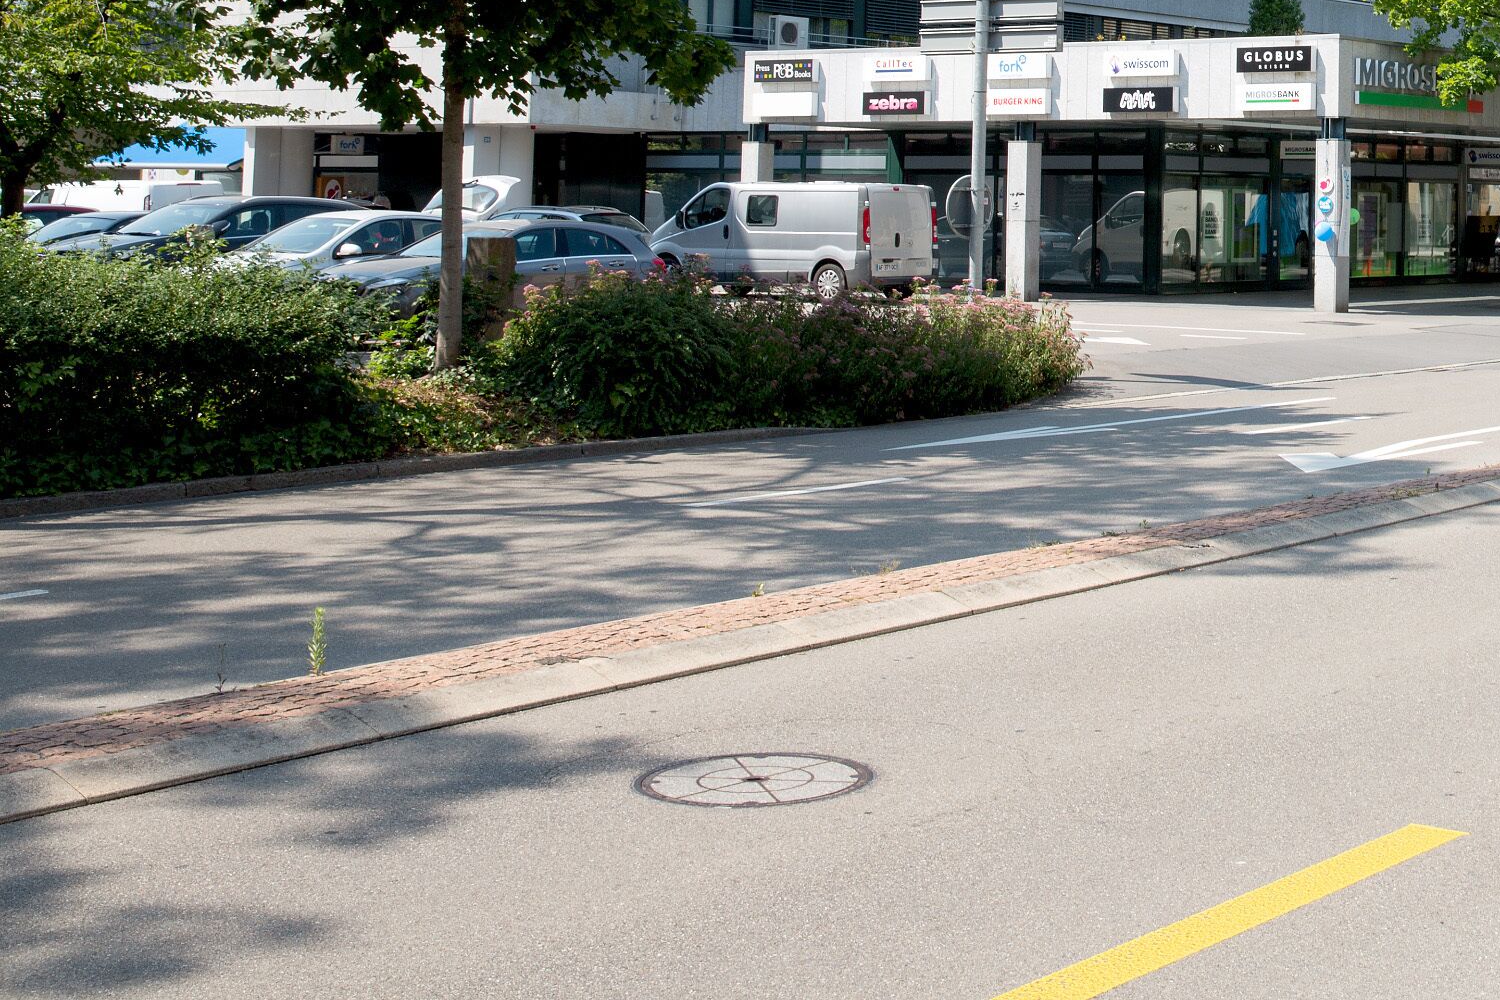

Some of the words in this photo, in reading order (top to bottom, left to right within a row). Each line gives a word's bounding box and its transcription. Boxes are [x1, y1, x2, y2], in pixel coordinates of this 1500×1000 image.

[1243, 50, 1304, 63] GLOBUS
[755, 64, 771, 72] Press
[876, 59, 913, 68] CallTec
[999, 60, 1023, 73] fork
[1123, 58, 1169, 69] swisscom
[773, 63, 794, 79] R&B
[794, 70, 811, 78] Books
[1354, 57, 1439, 93] MIGROS
[1119, 89, 1156, 110] cachet
[1246, 90, 1300, 99] MIGROSBANK
[868, 94, 918, 111] zebra
[993, 98, 1022, 106] BURGER
[1024, 97, 1043, 105] KING
